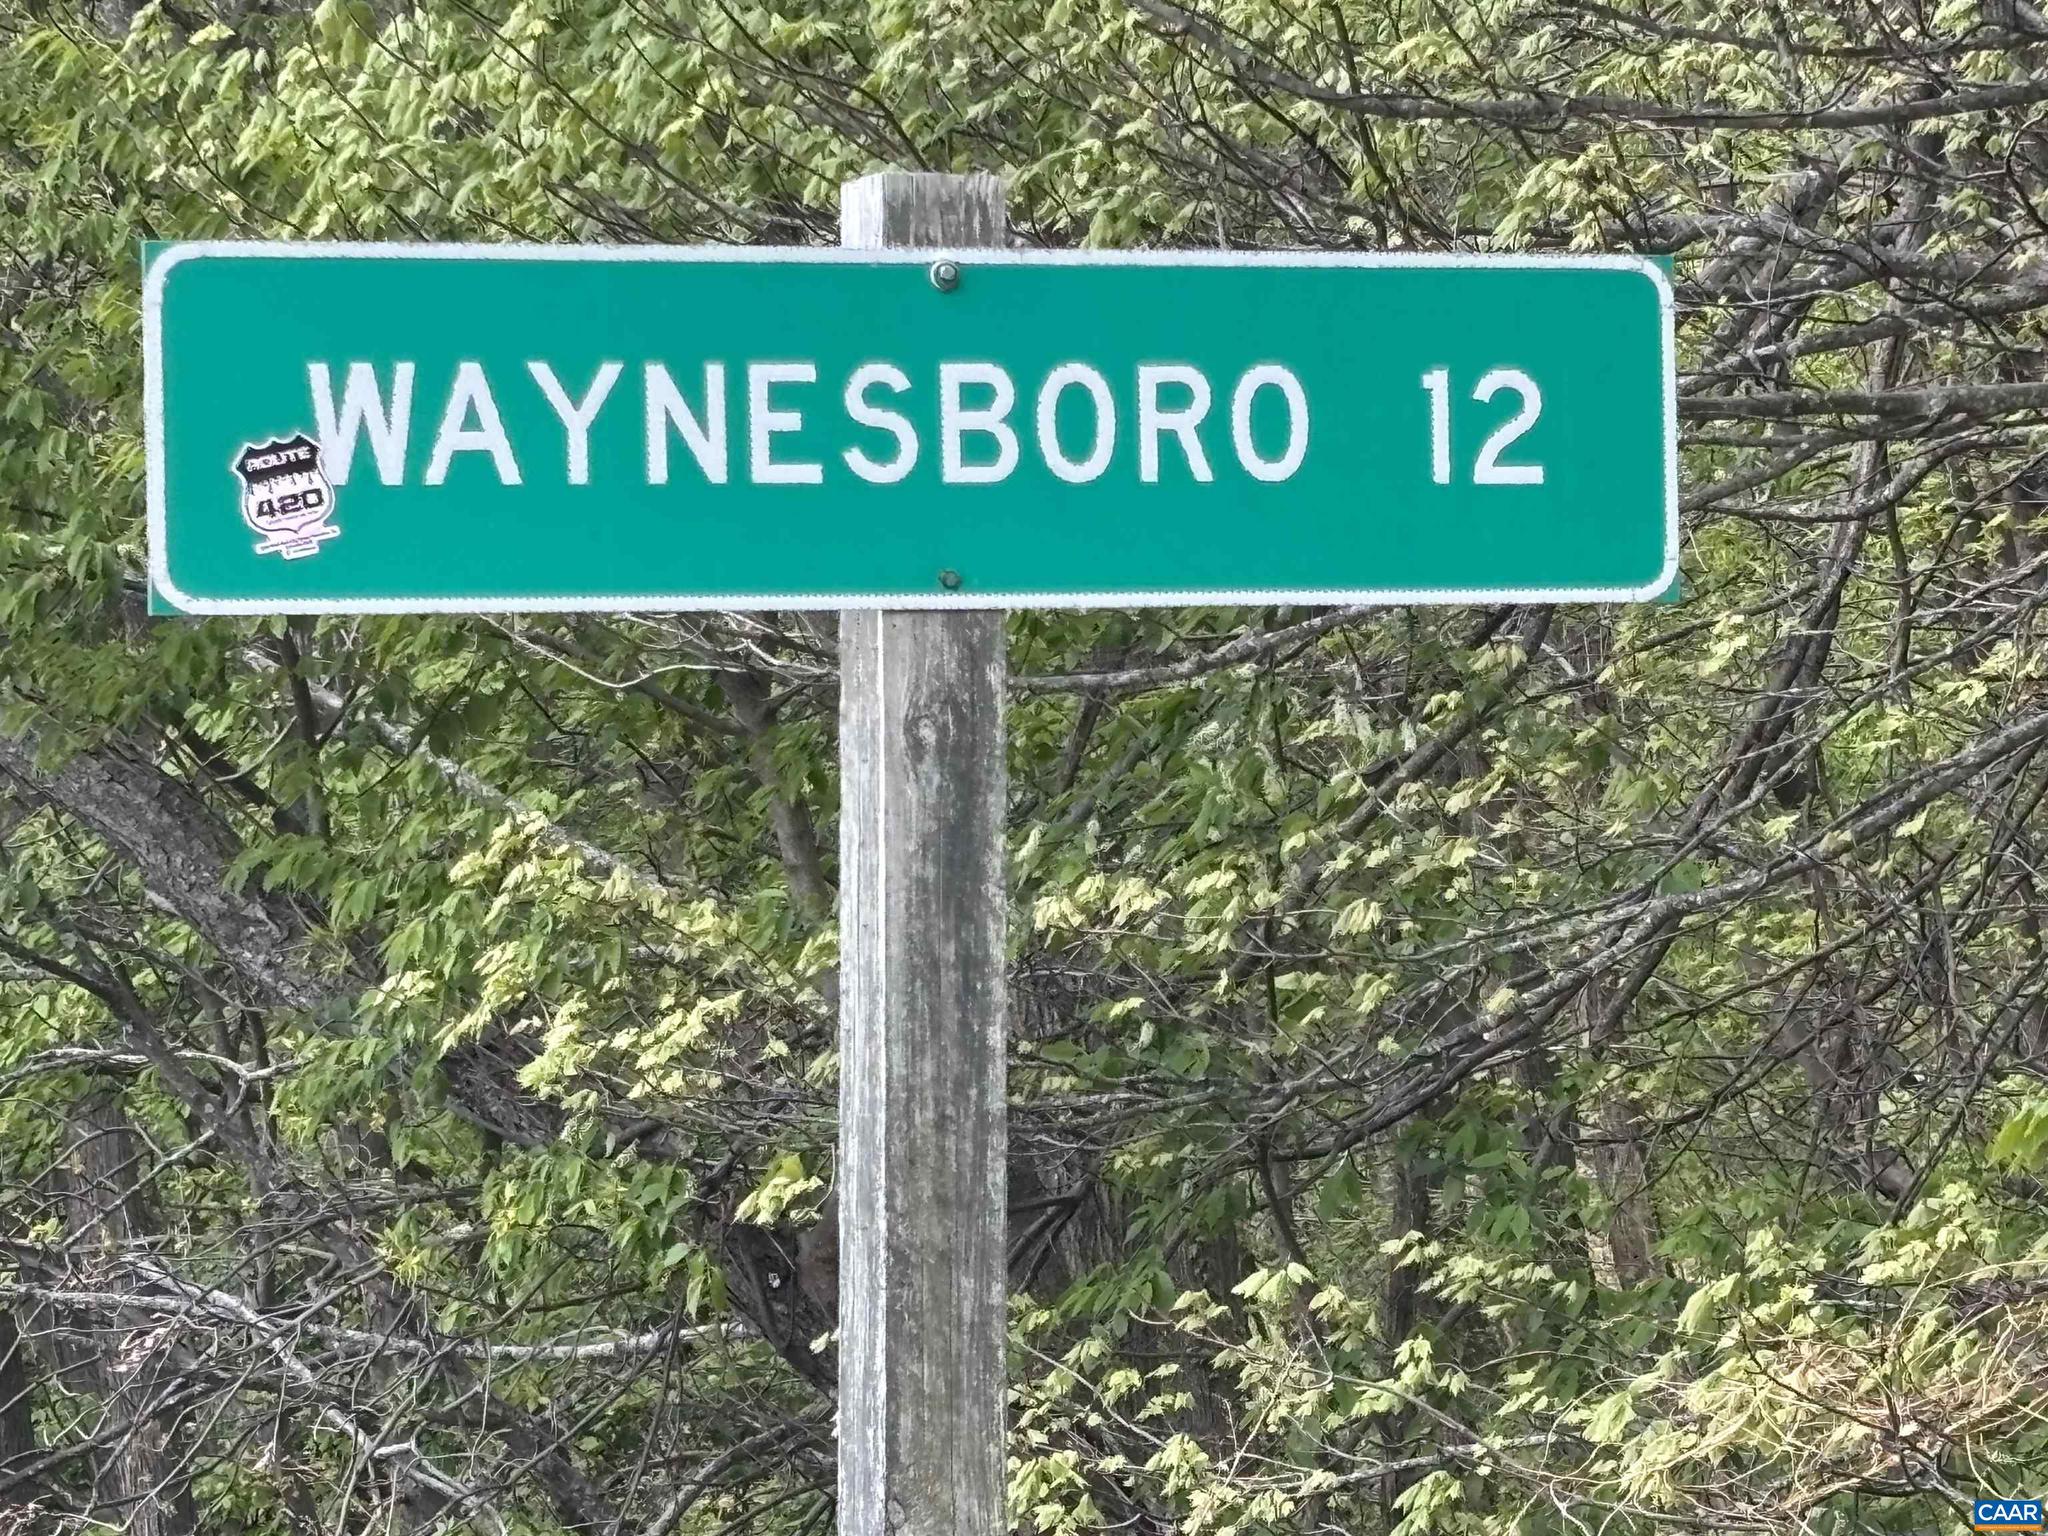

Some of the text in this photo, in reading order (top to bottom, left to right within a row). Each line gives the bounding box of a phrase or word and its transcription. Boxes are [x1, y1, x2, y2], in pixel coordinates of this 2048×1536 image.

[306, 361, 1545, 486] WAYNESBORO 12
[244, 446, 312, 473] ROUTE
[256, 488, 325, 519] 420
